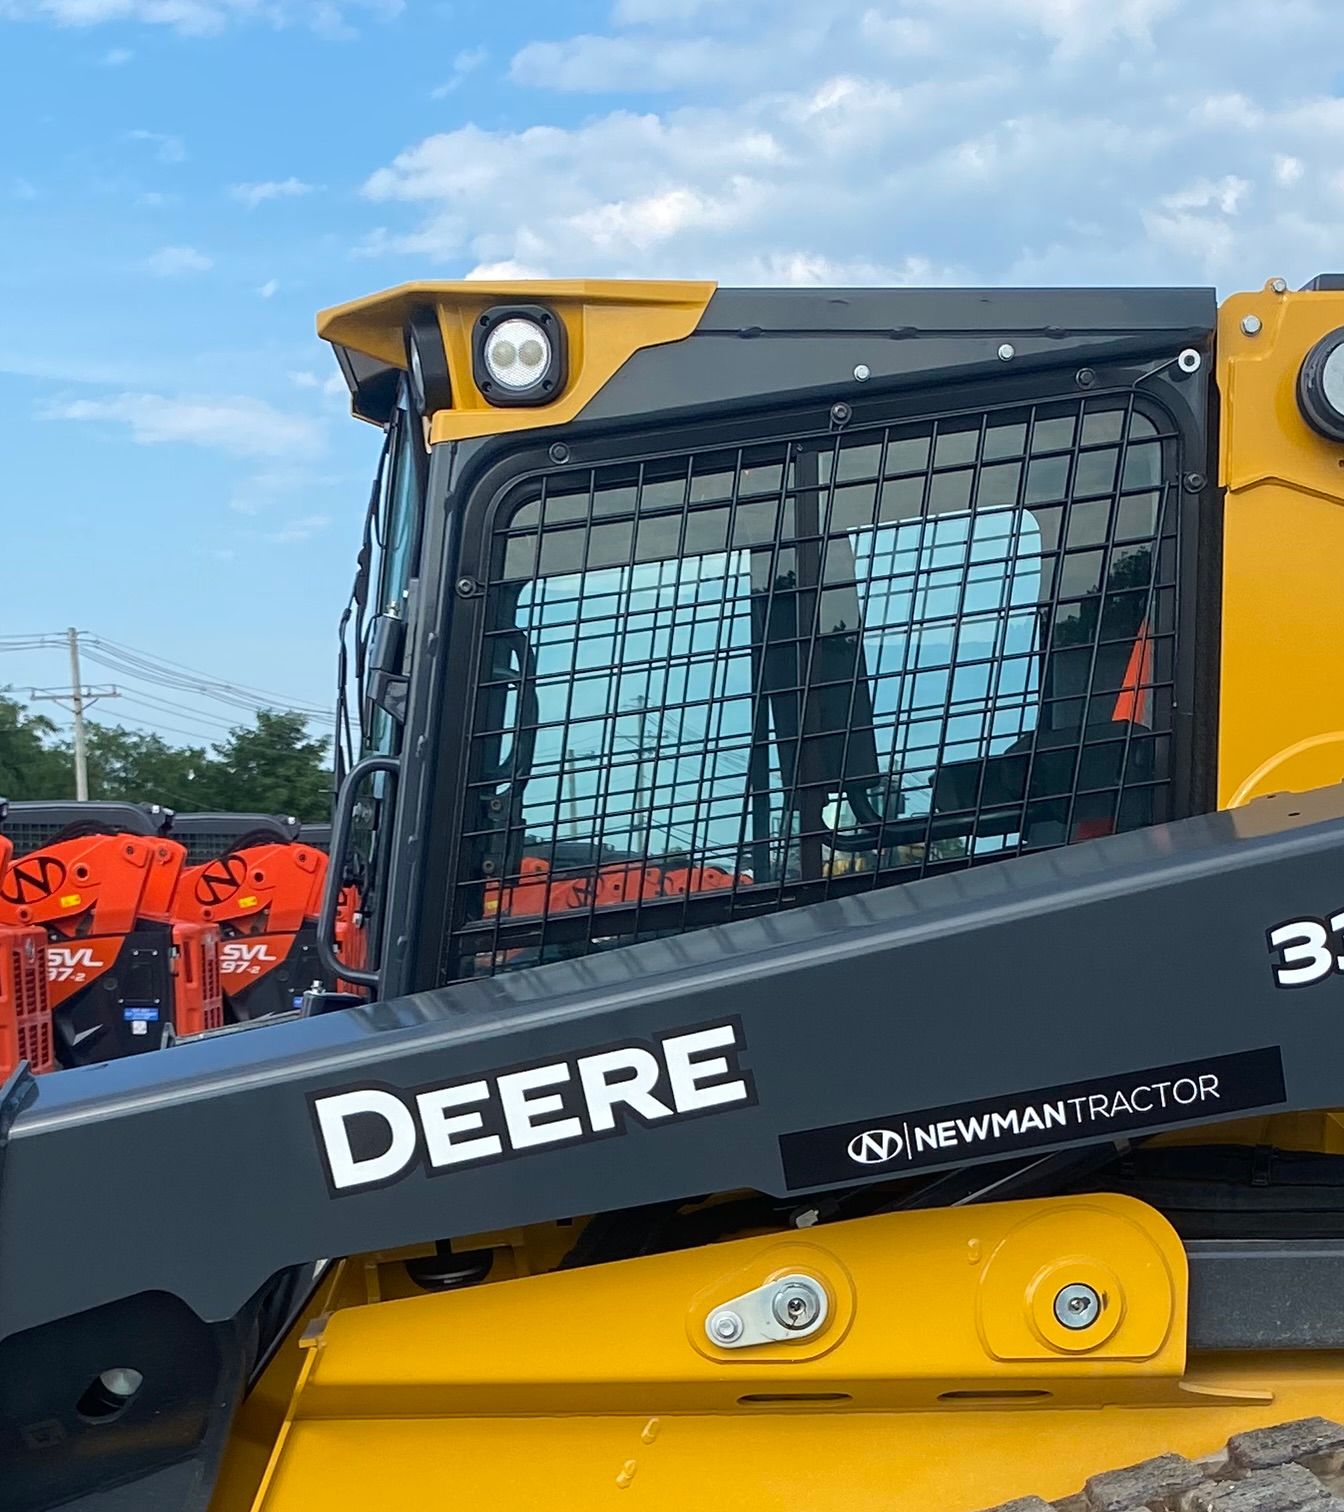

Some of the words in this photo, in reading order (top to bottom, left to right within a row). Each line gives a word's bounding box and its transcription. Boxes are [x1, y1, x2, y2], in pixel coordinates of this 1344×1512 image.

[47, 948, 104, 967] SVL
[219, 944, 277, 960] SVL
[219, 960, 261, 974] 97-2
[314, 1024, 748, 1190] DEERE
[914, 1102, 1067, 1152] NEWMAN
[1067, 1073, 1221, 1124] TRACTOR
